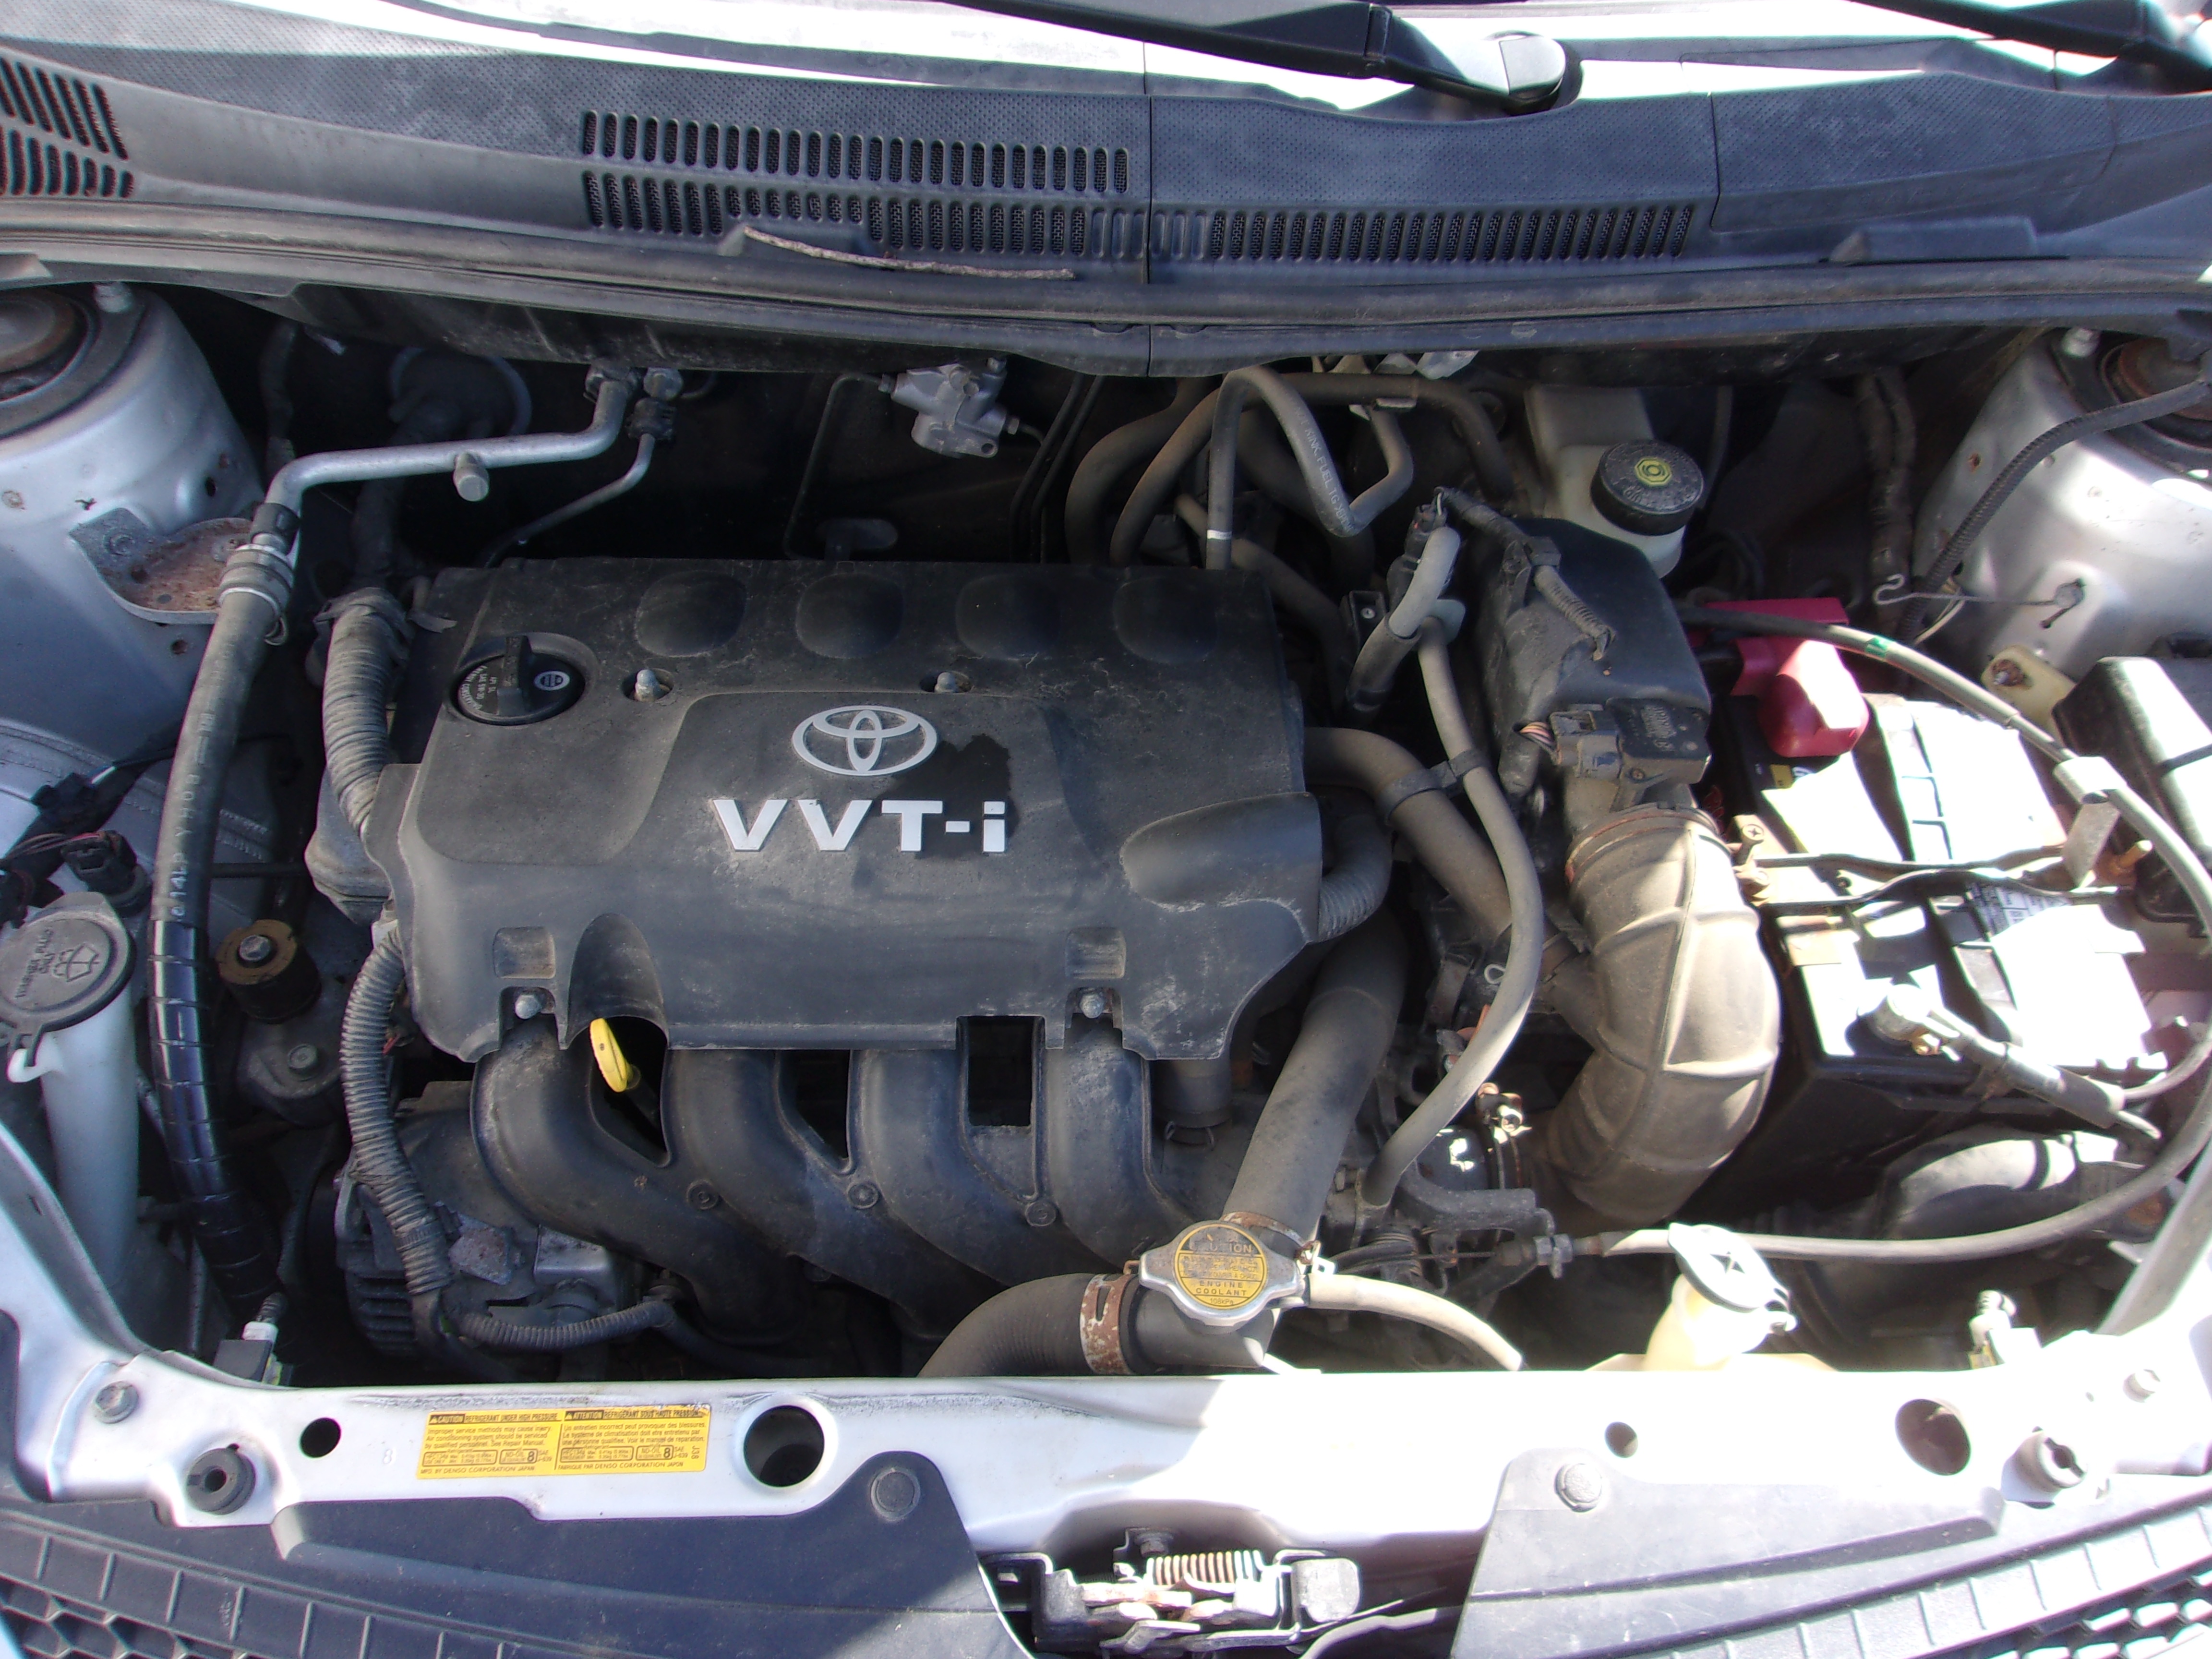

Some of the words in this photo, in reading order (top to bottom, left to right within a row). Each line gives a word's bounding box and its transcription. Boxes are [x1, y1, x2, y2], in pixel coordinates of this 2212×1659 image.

[1317, 456, 1334, 488] FUEL
[1329, 487, 1339, 504] TG
[1199, 1280, 1243, 1288] ENGINE
[1196, 1287, 1247, 1296] COOLANT
[437, 1415, 464, 1423] CAUTION
[465, 1414, 500, 1422] REFRIGERANT
[573, 1411, 603, 1420] ATTENTION
[527, 1451, 535, 1462] 8
[663, 1447, 671, 1458] 8
[691, 1445, 700, 1459] J38
